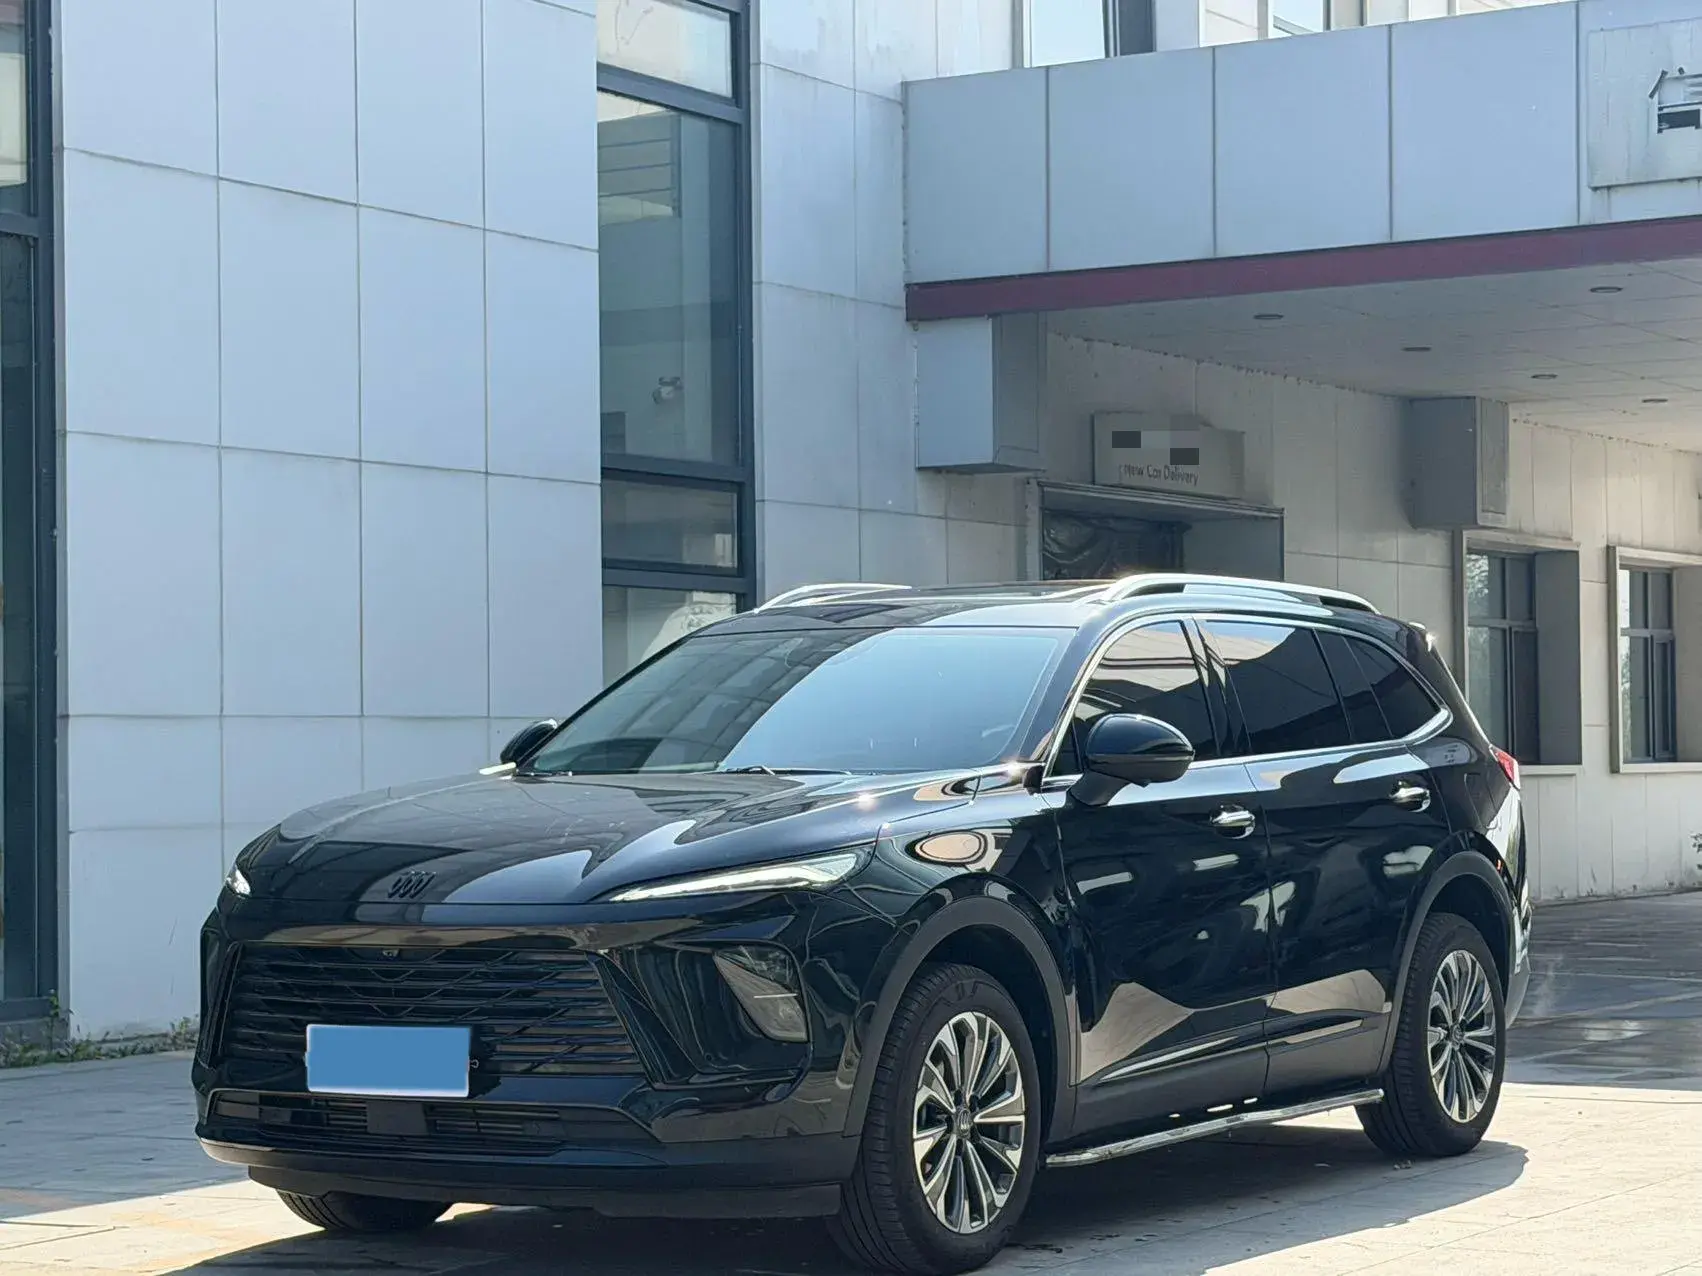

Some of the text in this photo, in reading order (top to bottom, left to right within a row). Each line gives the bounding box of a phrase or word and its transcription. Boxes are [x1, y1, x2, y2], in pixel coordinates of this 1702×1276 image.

[1124, 463, 1199, 487] New Car Delivery
